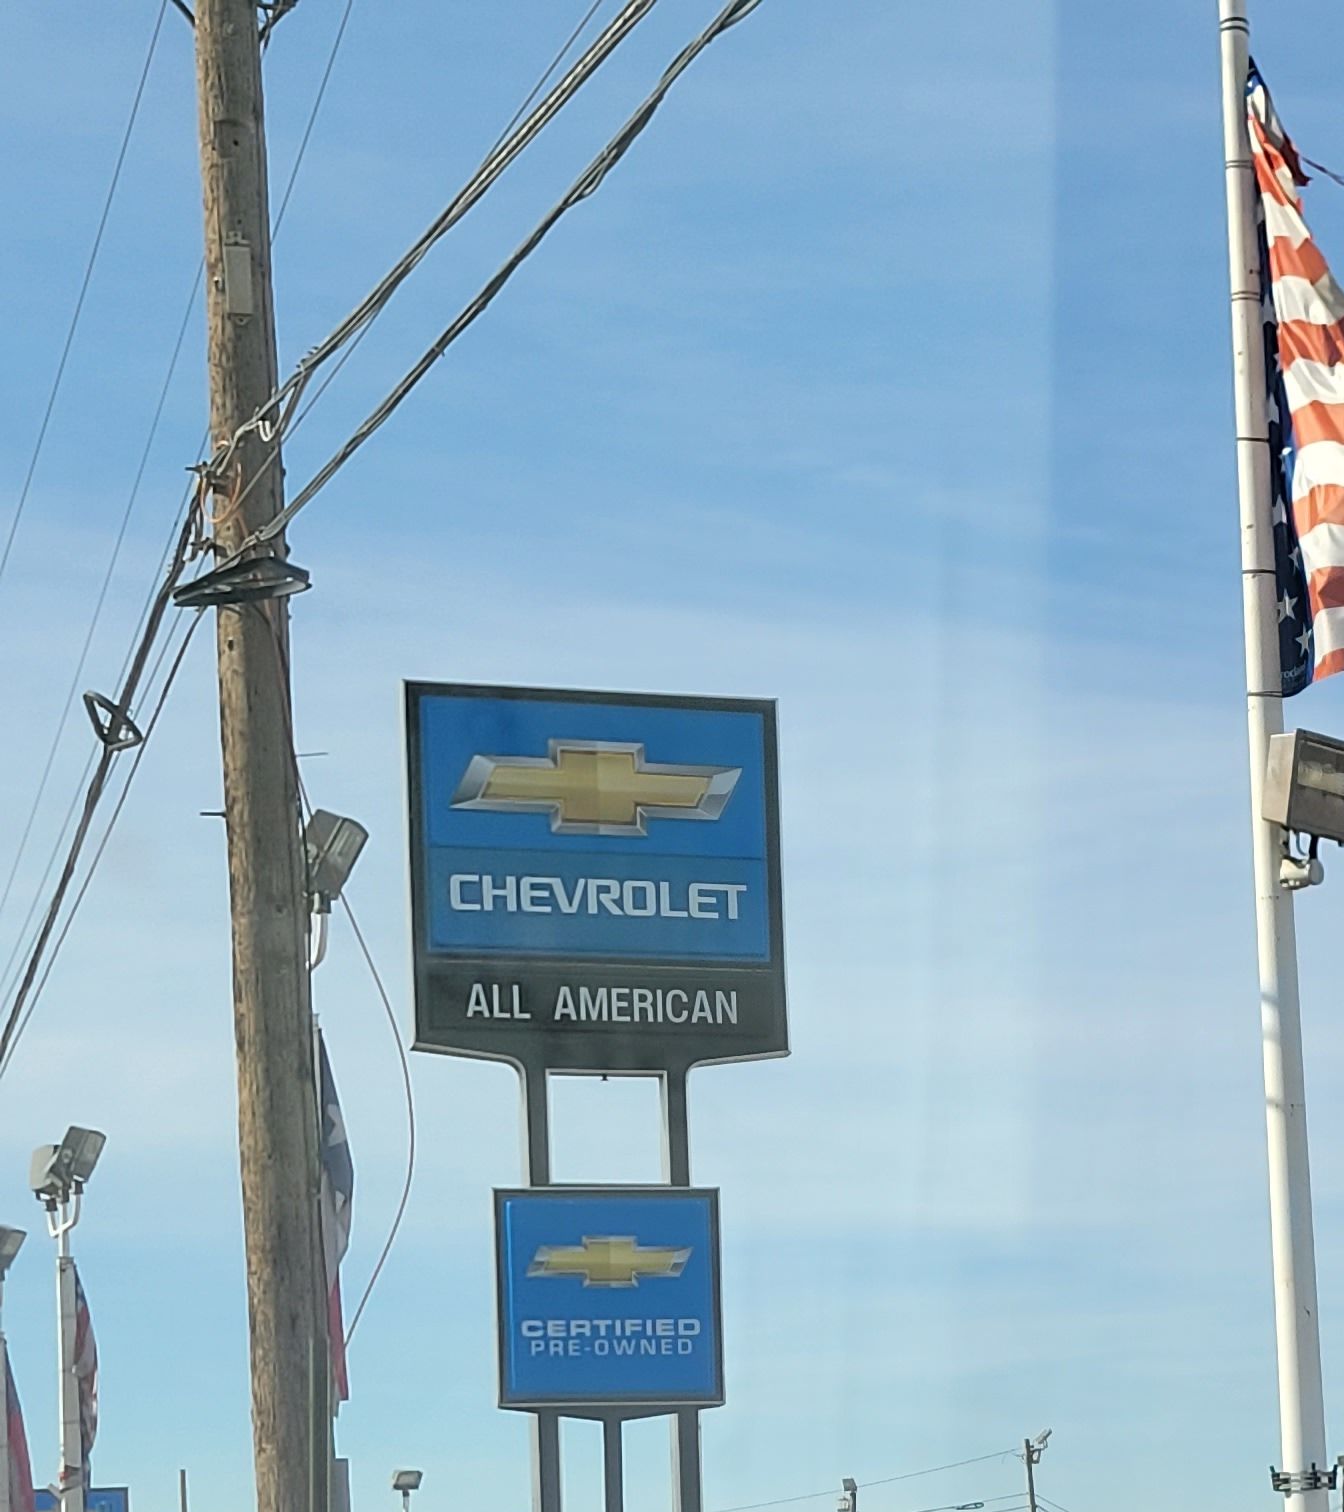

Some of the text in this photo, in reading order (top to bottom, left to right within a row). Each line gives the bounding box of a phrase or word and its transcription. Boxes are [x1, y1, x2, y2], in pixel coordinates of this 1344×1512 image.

[449, 873, 748, 920] CHEVROLET
[466, 982, 738, 1024] ALL AMERICAN
[521, 1318, 701, 1337] CERTIFIED
[531, 1339, 693, 1356] PRE-OWNED
